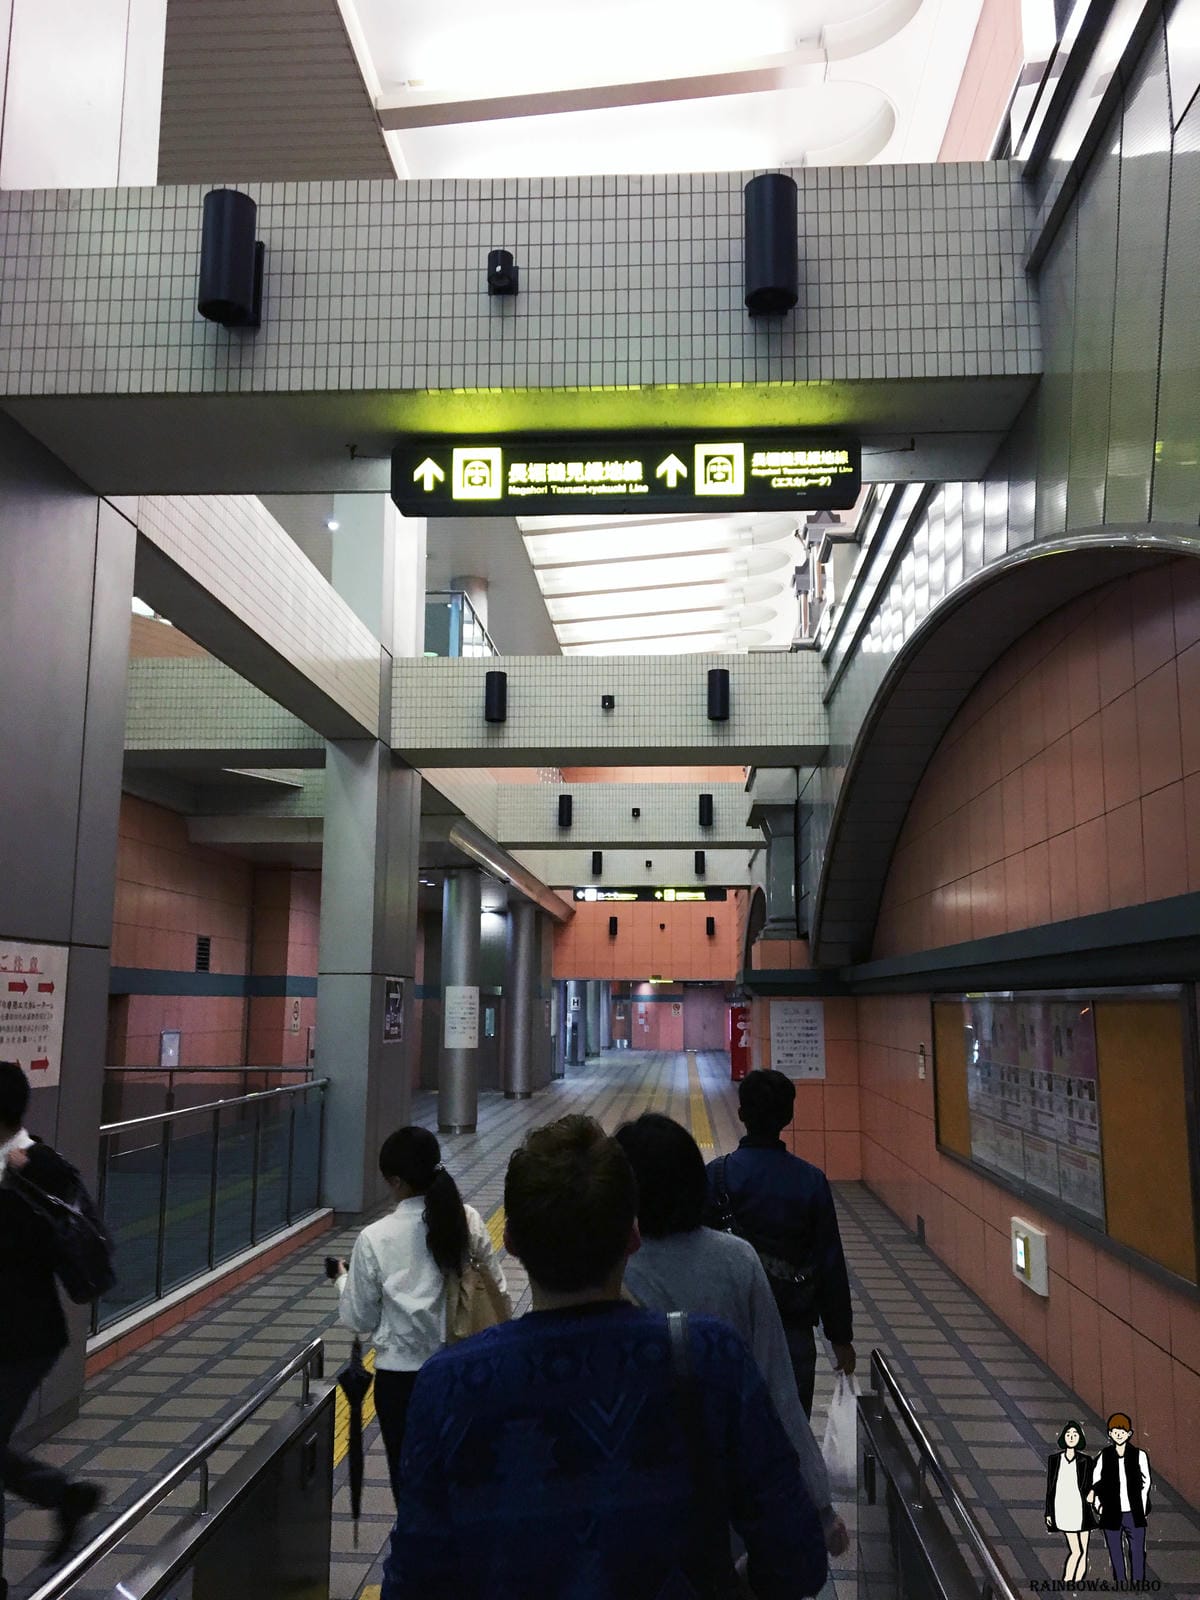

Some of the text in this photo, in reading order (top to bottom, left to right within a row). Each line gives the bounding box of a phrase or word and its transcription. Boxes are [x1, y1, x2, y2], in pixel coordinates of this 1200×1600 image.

[508, 483, 649, 496] Nagahori Tsurumi-ryokuchi Line
